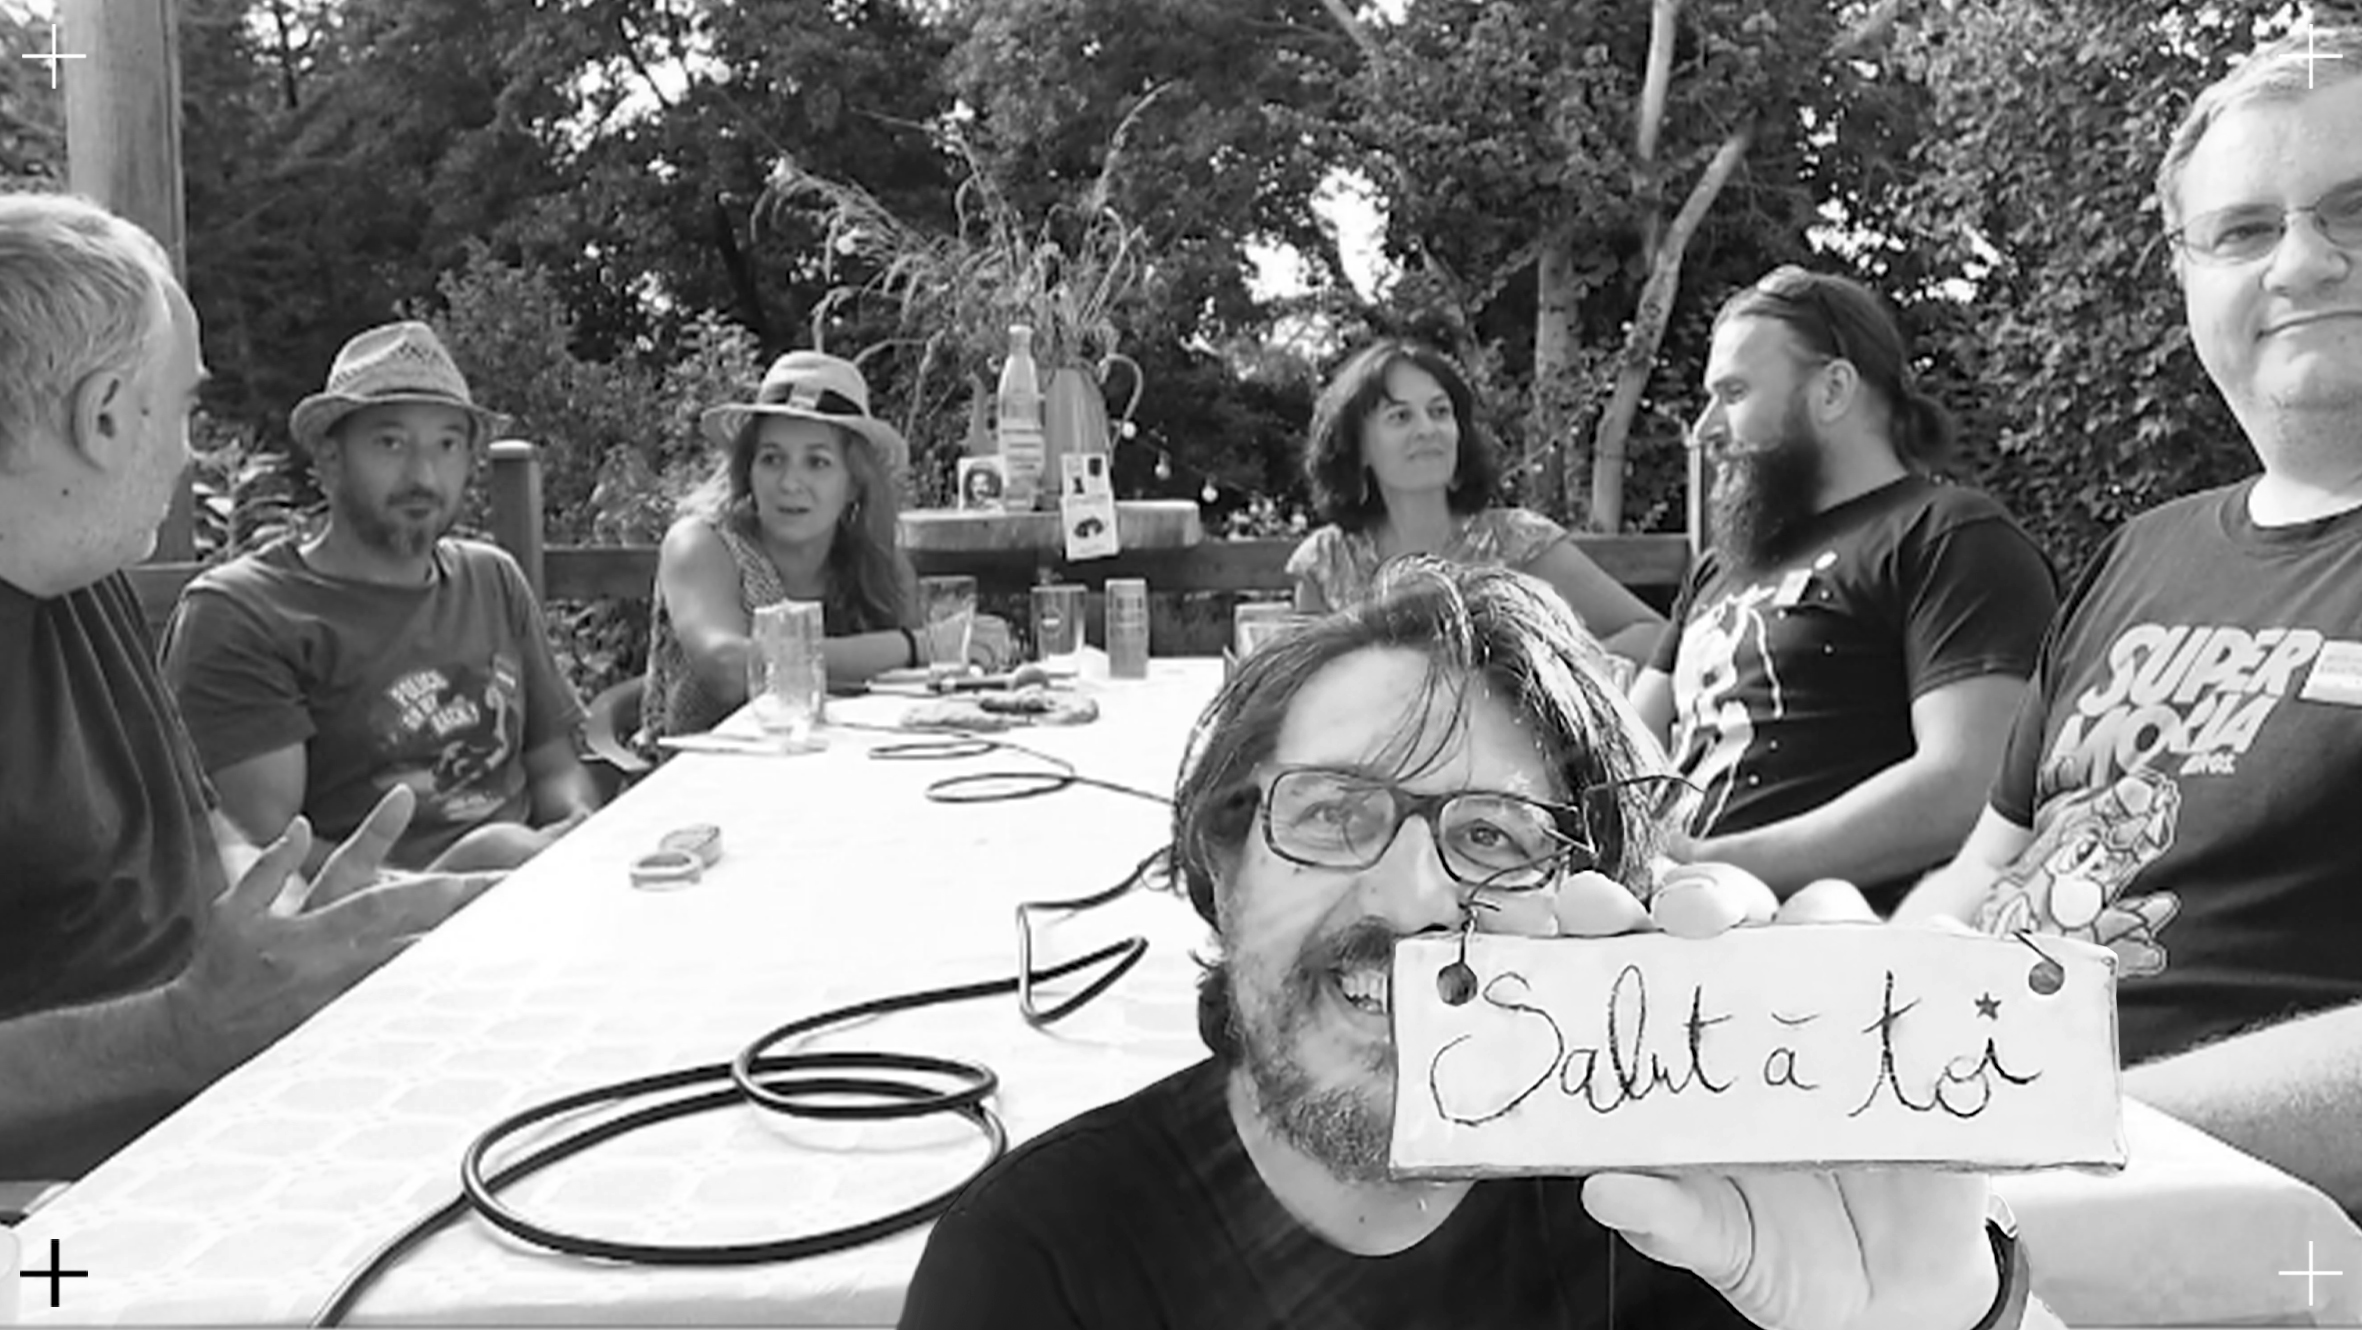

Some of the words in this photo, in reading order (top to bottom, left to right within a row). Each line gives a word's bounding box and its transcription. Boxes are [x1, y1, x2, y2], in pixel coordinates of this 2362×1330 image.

[2078, 624, 2324, 717] SUPER
[1429, 963, 1740, 1127] Salut
[1846, 969, 2042, 1118] toi
